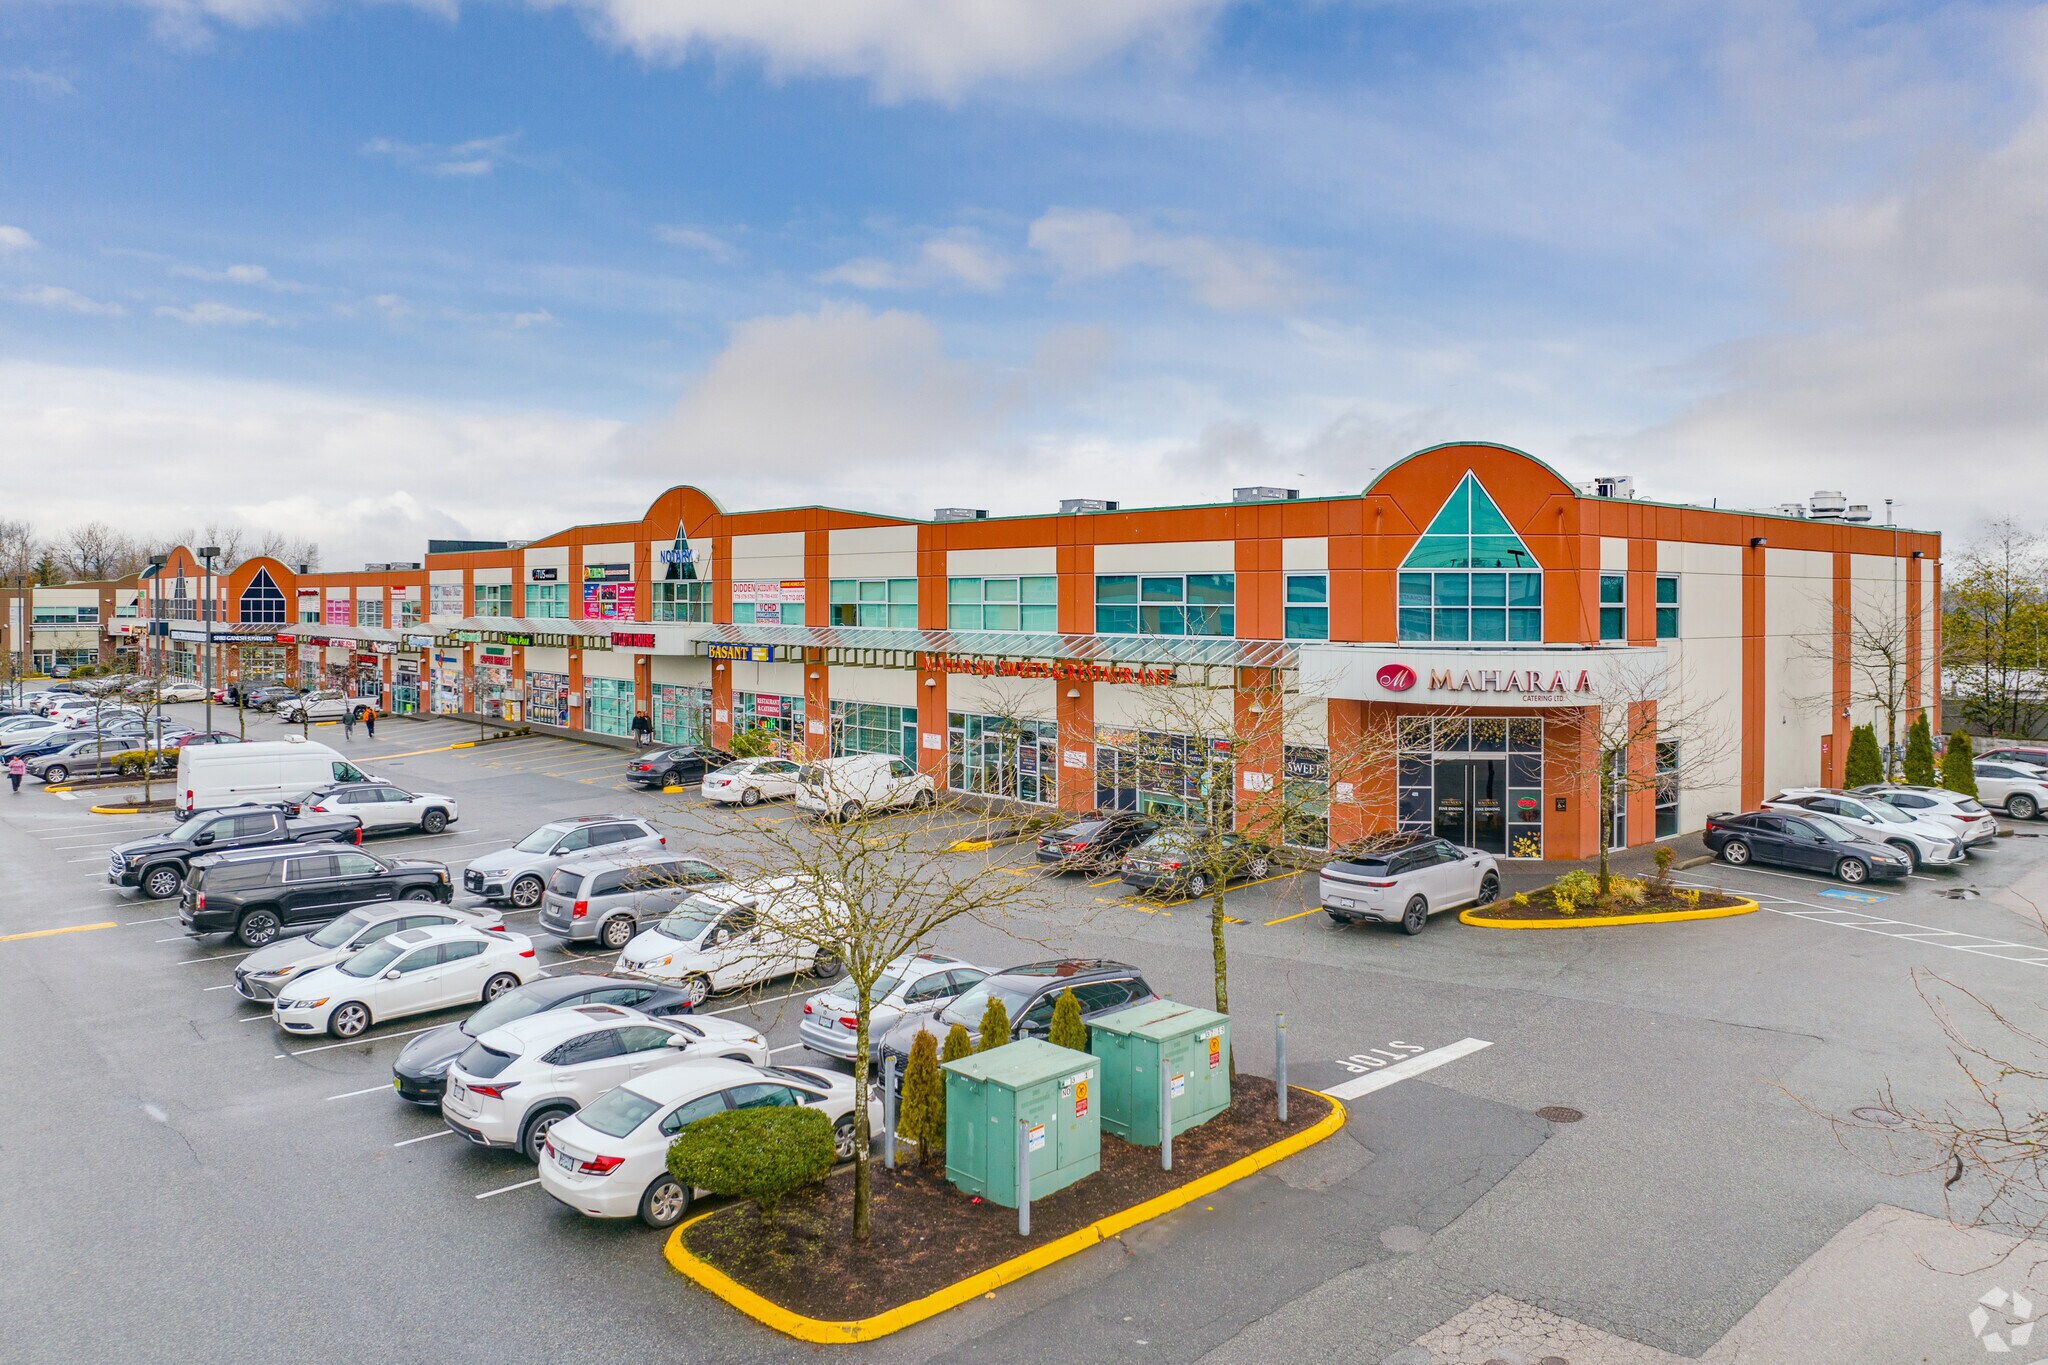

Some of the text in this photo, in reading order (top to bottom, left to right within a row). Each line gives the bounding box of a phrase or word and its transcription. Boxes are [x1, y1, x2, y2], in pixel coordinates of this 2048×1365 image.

[660, 549, 692, 563] NOTARY
[733, 583, 755, 593] DIDDEN
[634, 633, 656, 648] HOUSE
[708, 644, 749, 660] BASANT
[924, 656, 1172, 686] MAHARAJA SWEETS & RESTAURANT
[1522, 694, 1553, 702] CATERING
[1335, 1040, 1425, 1074] STOP
